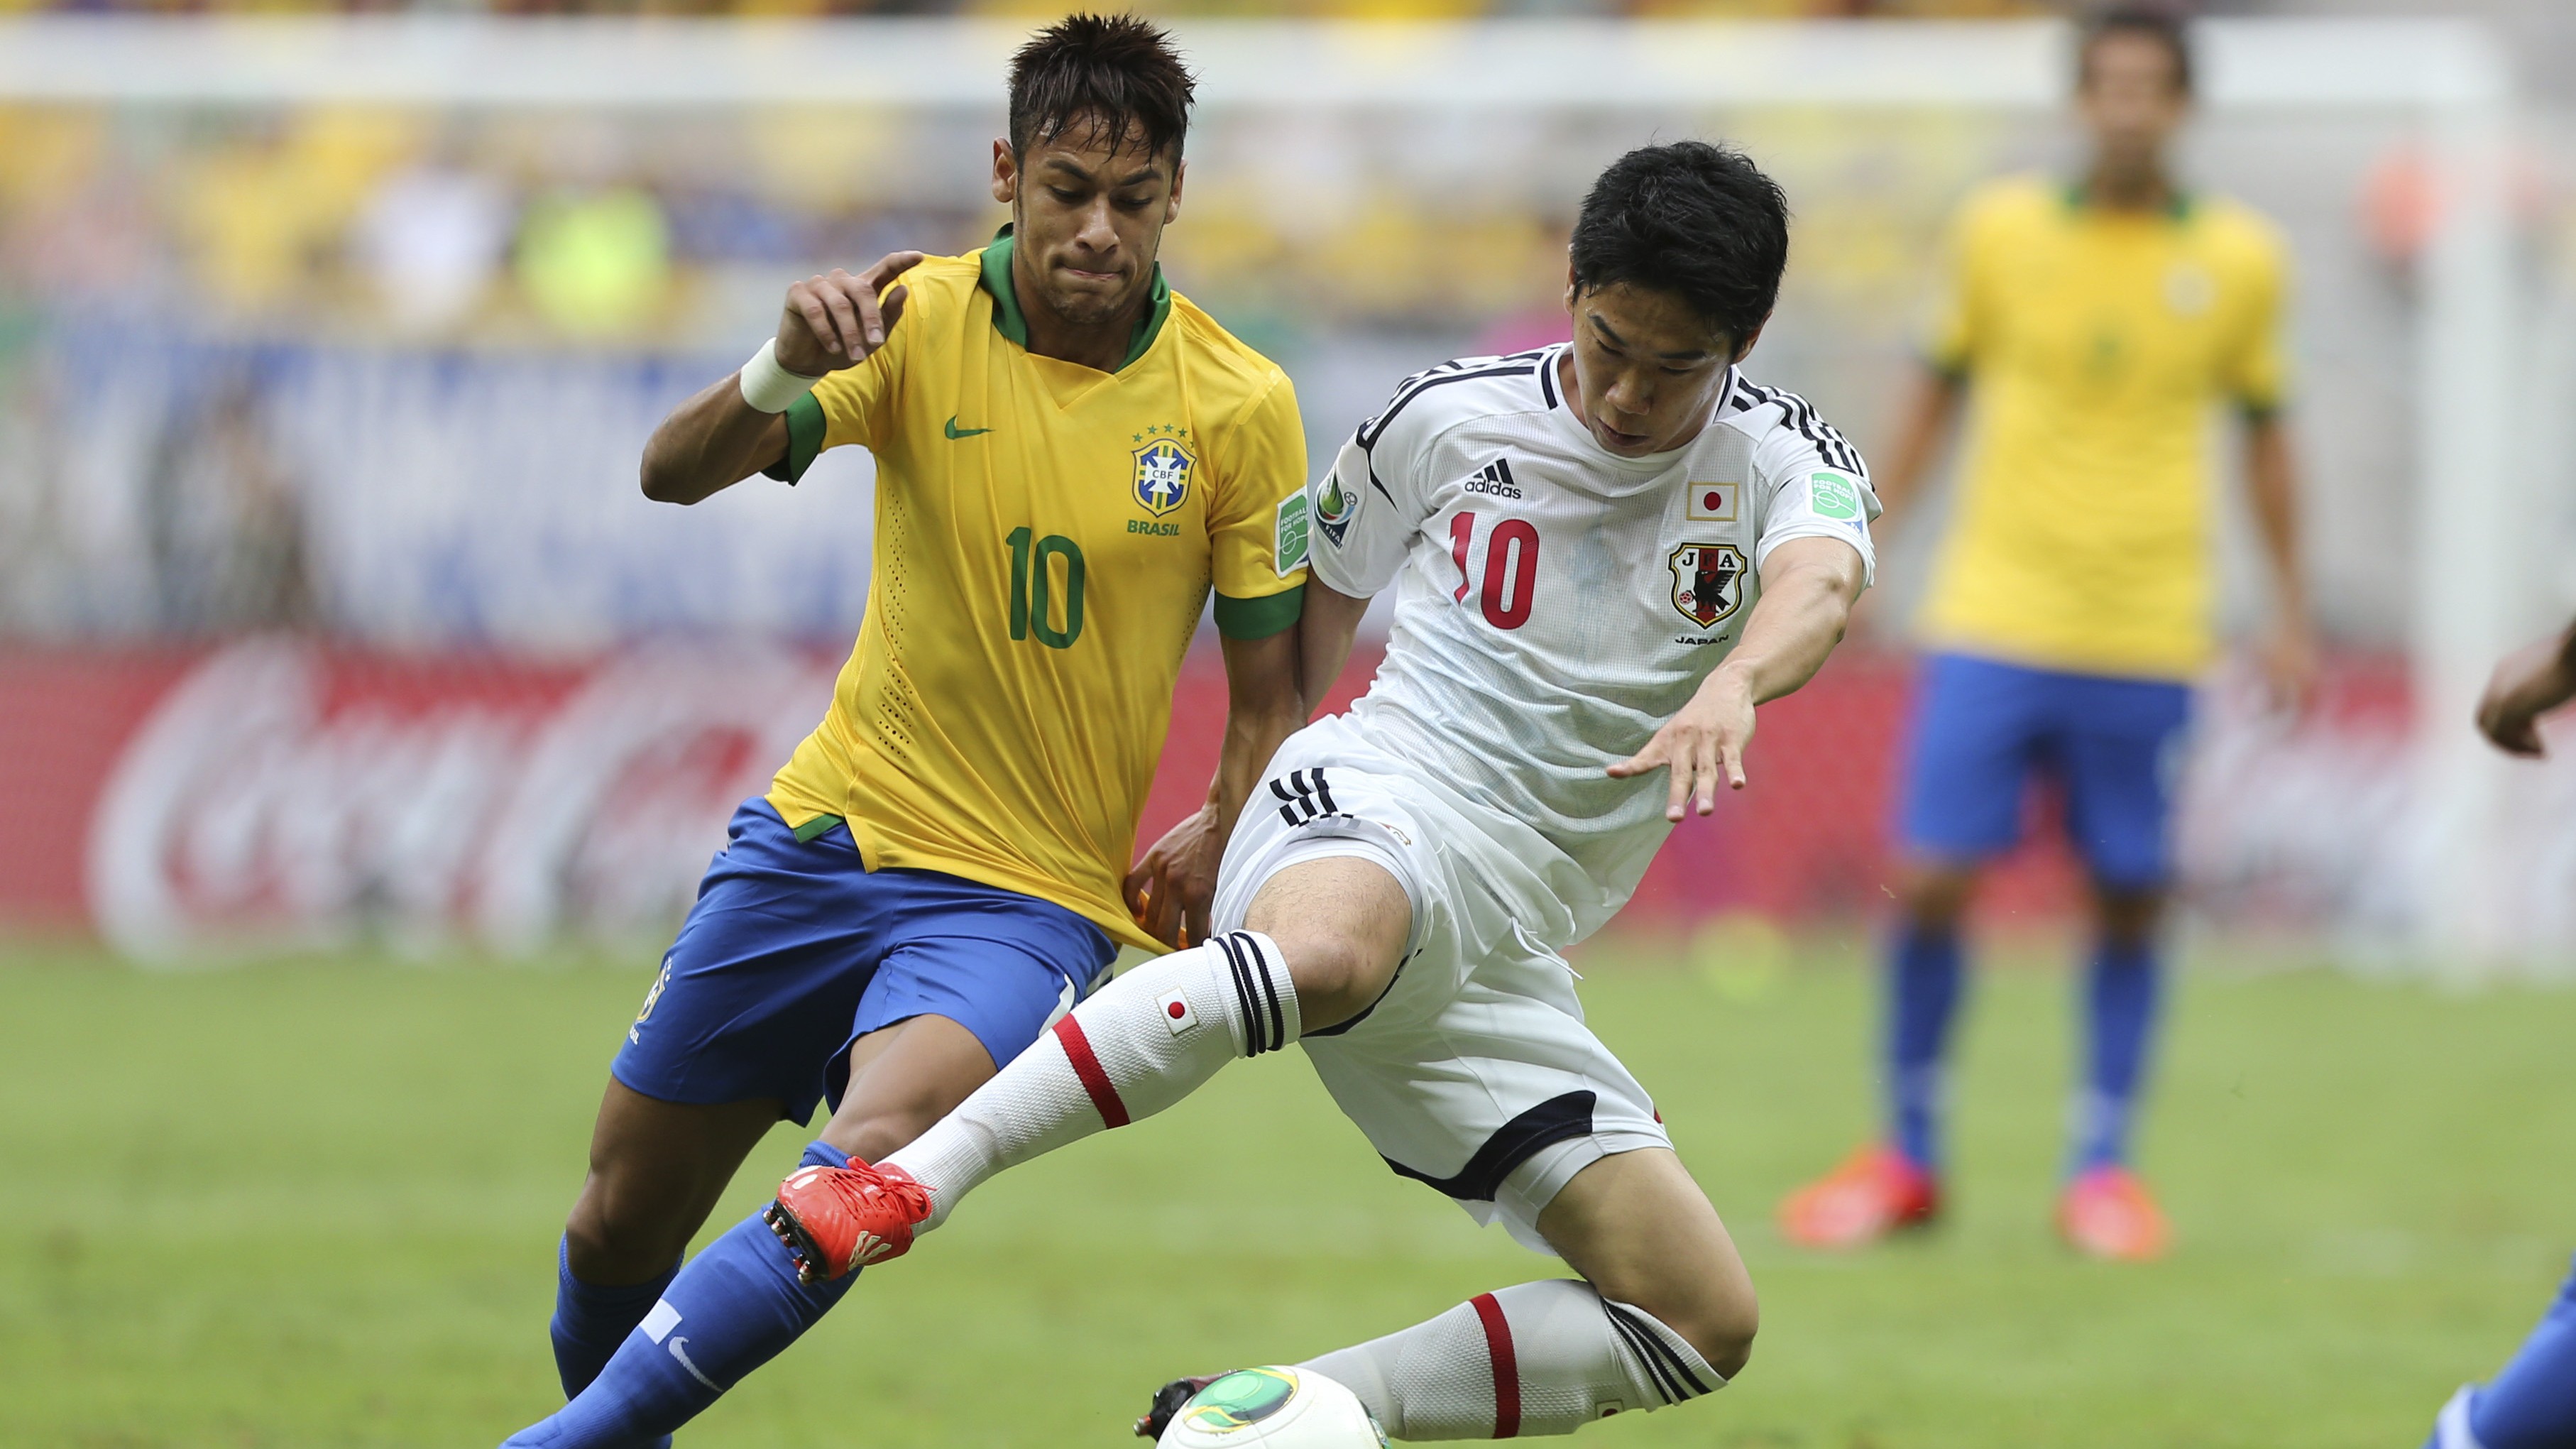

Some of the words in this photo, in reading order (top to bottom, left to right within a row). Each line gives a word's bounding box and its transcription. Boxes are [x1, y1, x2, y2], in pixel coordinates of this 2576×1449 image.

[1152, 469, 1173, 480] CBF
[1464, 478, 1522, 499] adidas
[1813, 479, 1854, 497] FOOTBALL
[1834, 488, 1854, 503] HOPE
[1281, 506, 1307, 525] FOOTBAL
[1127, 519, 1180, 537] BRASIL
[1281, 523, 1292, 534] FOR
[1325, 525, 1341, 542] FIFA
[1682, 552, 1736, 568] JFA
[1449, 510, 1540, 630] 10
[1005, 526, 1085, 650] 10
[1675, 635, 1729, 645] JAPAN
